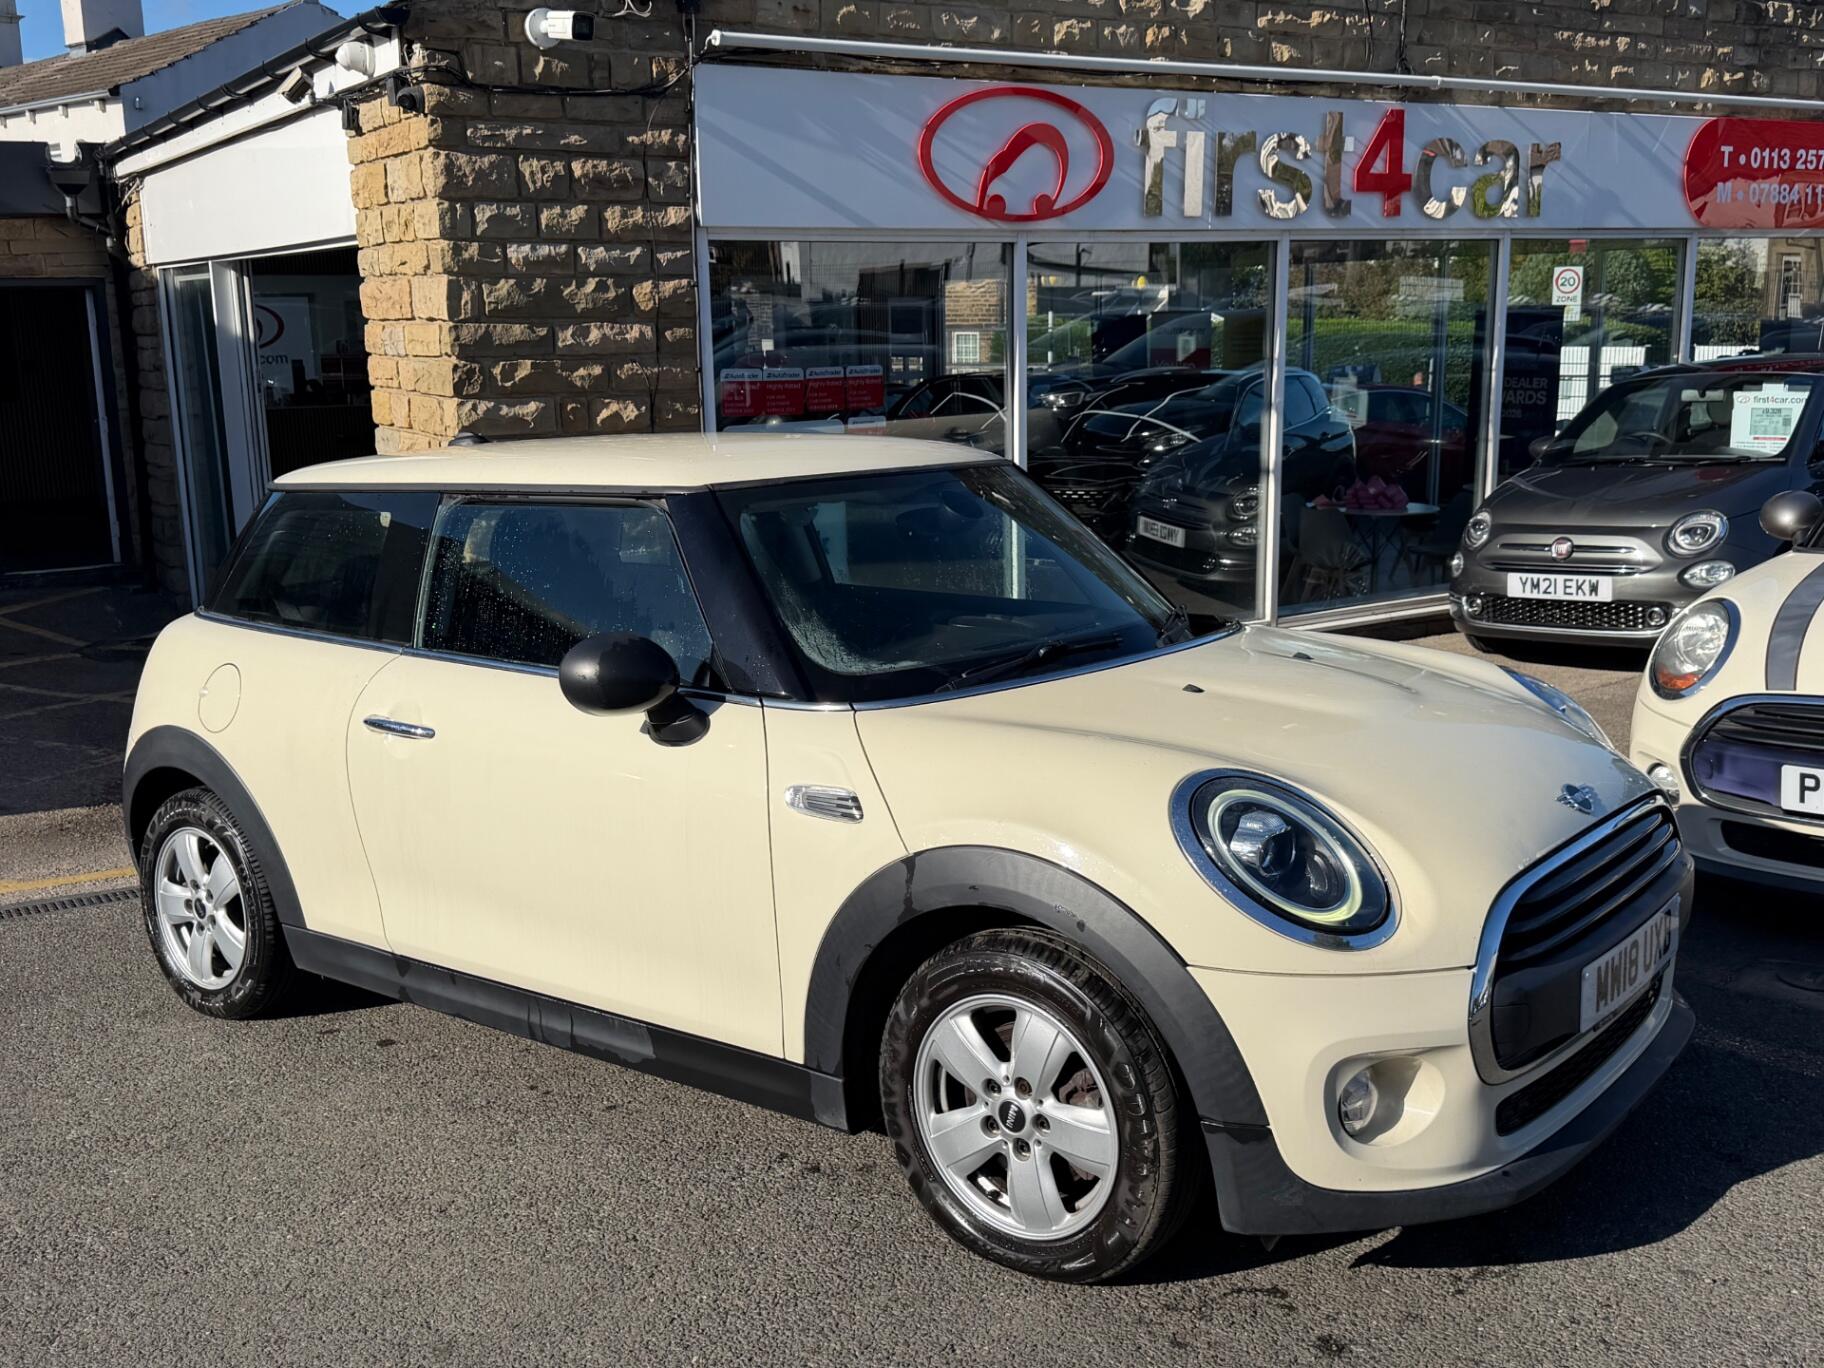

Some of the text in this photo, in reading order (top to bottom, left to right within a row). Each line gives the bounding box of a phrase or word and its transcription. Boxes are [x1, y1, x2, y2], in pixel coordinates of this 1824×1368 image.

[1136, 98, 1562, 219] first4car
[1721, 145, 1733, 167] T
[1750, 147, 1790, 169] 0113
[1717, 181, 1732, 204] M
[1749, 183, 1800, 204] 07884
[1560, 276, 1576, 287] 20
[1556, 295, 1578, 303] ZONE
[1504, 376, 1548, 389] DEALER
[1503, 390, 1547, 405] ARDS
[1519, 577, 1599, 597] YM21 EKW
[1799, 772, 1821, 804] P
[1596, 939, 1639, 1013] MW18
[1005, 1104, 1019, 1129] MINI
